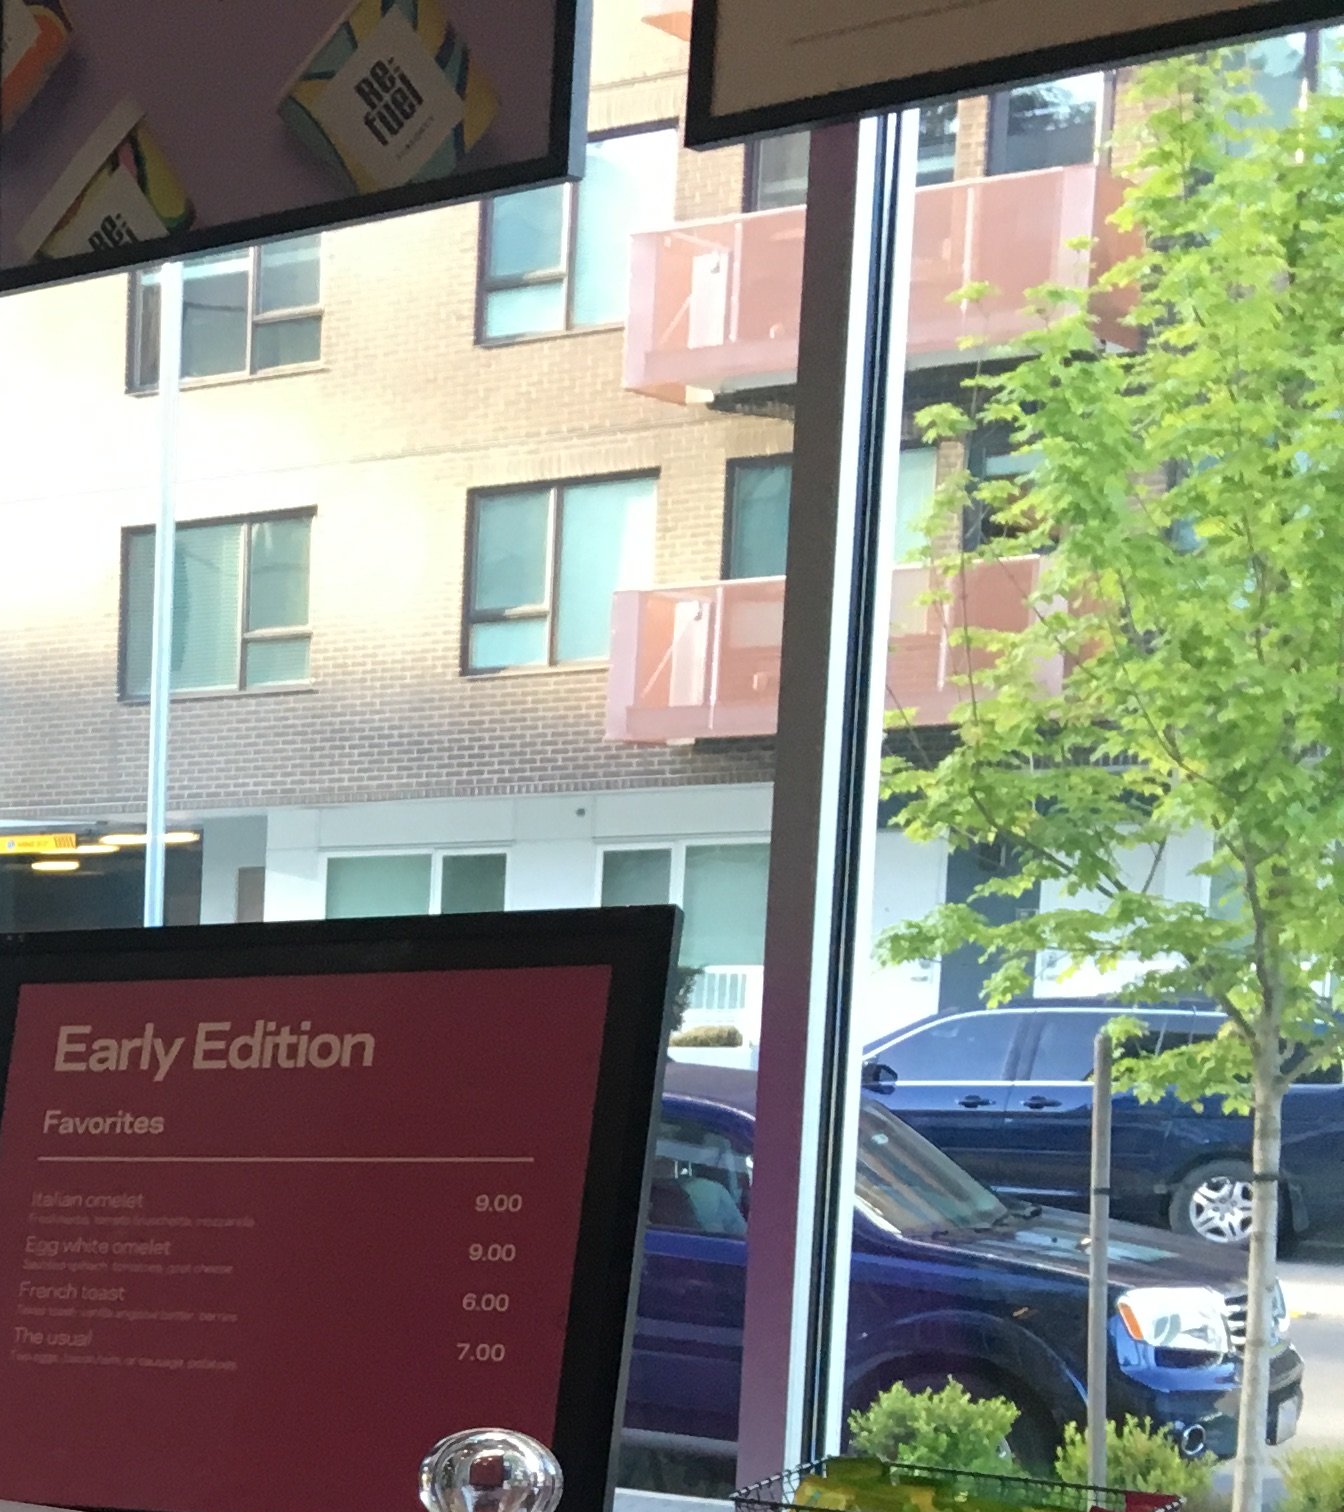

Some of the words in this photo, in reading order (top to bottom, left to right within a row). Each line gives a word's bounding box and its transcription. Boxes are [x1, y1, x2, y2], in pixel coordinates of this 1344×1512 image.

[363, 72, 424, 146] fuel
[54, 1023, 185, 1082] Early
[193, 1020, 375, 1070] Edition
[43, 1110, 165, 1135] Favorites
[31, 1191, 83, 1208] Italian
[85, 1193, 144, 1209] omelet
[474, 1194, 523, 1213] 9.00
[25, 1236, 59, 1257] Egg
[62, 1238, 109, 1255] white
[112, 1240, 172, 1256] omelet
[468, 1243, 516, 1262] 9.00
[19, 1278, 78, 1300] French
[81, 1281, 126, 1301] toast
[462, 1293, 510, 1312] 6.00
[15, 1327, 44, 1345] The
[46, 1329, 93, 1347] usual
[456, 1342, 506, 1362] 7.00
